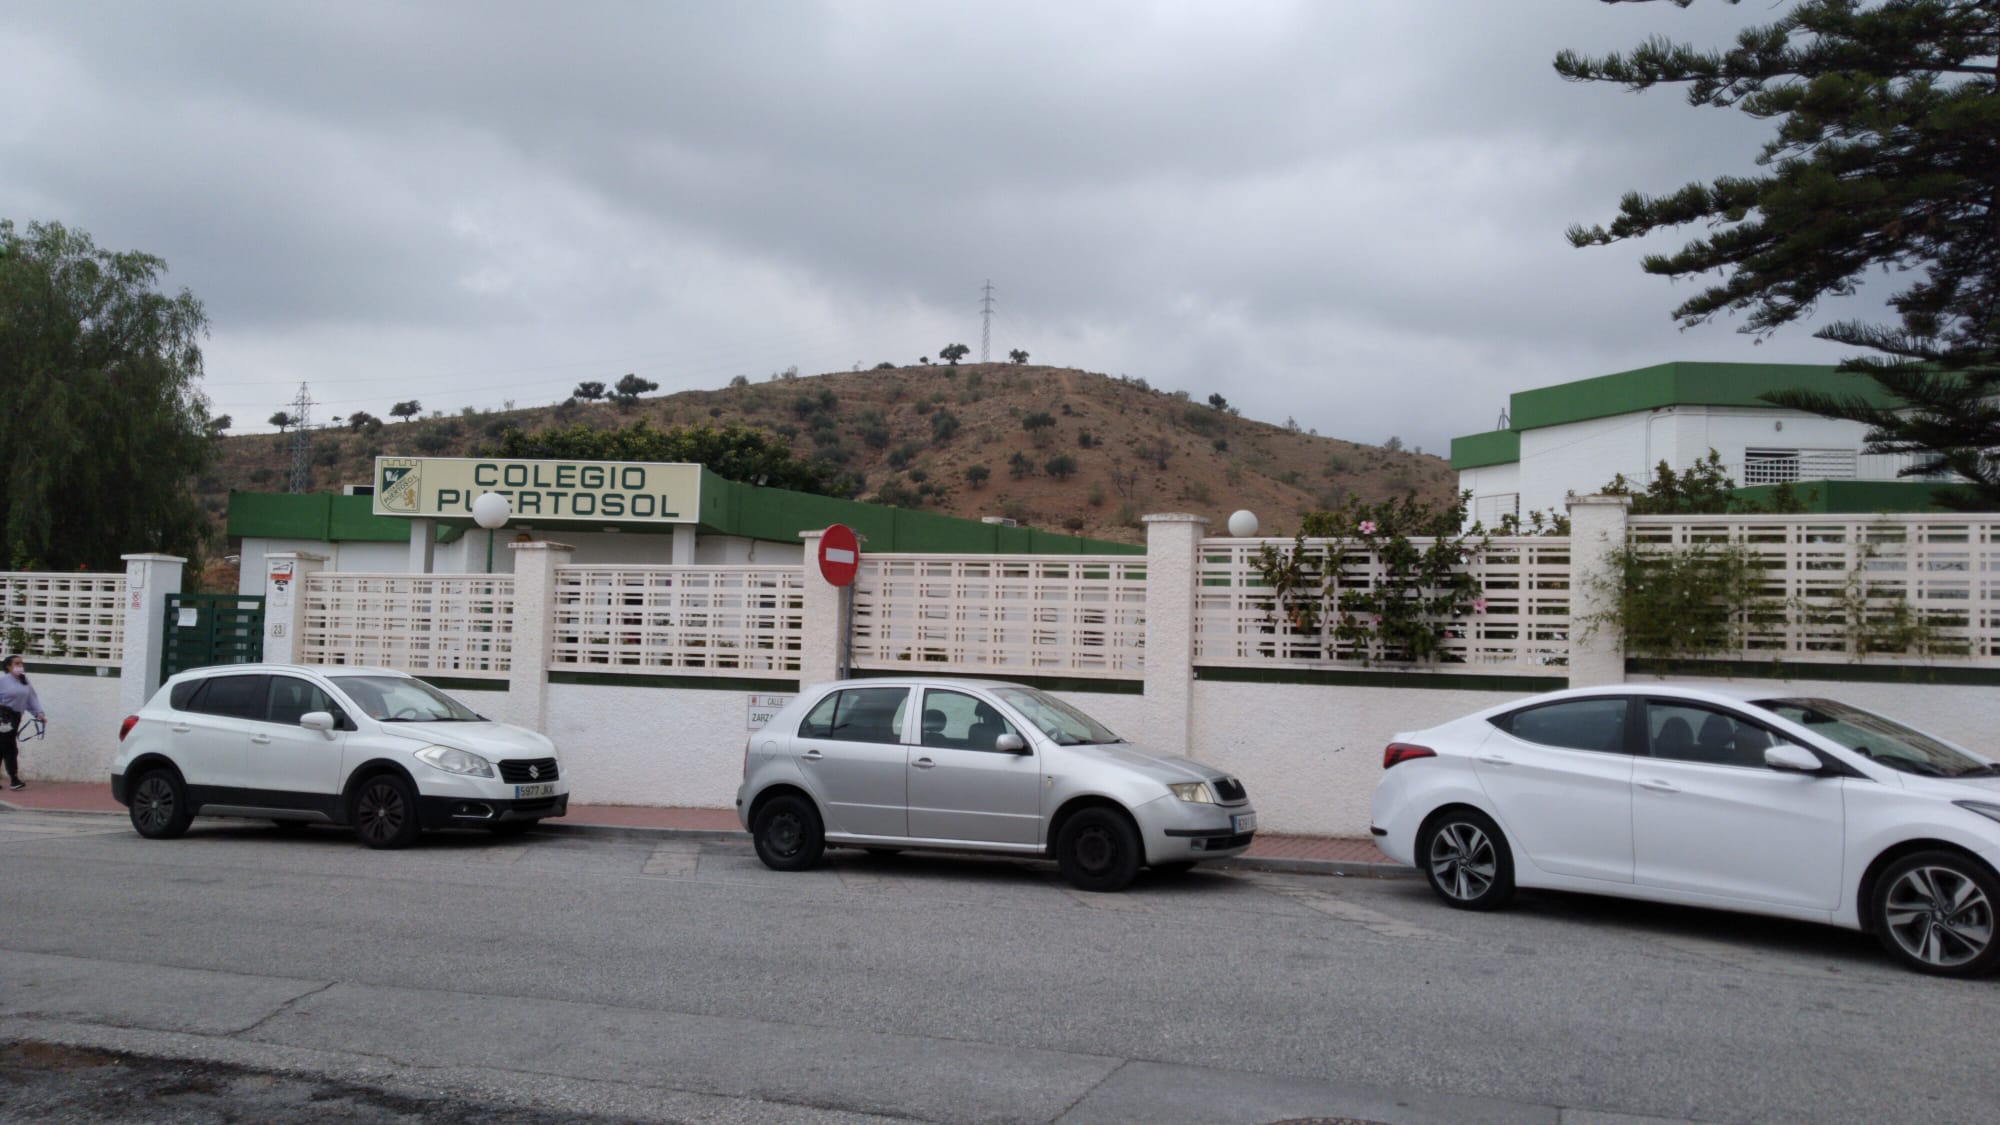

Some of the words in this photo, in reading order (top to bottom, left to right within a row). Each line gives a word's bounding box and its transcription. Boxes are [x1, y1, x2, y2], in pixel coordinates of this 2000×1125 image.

[474, 463, 646, 490] COLEGIO
[436, 488, 680, 518] PRTOSOL
[273, 625, 282, 634] 23
[767, 697, 784, 706] CALLE
